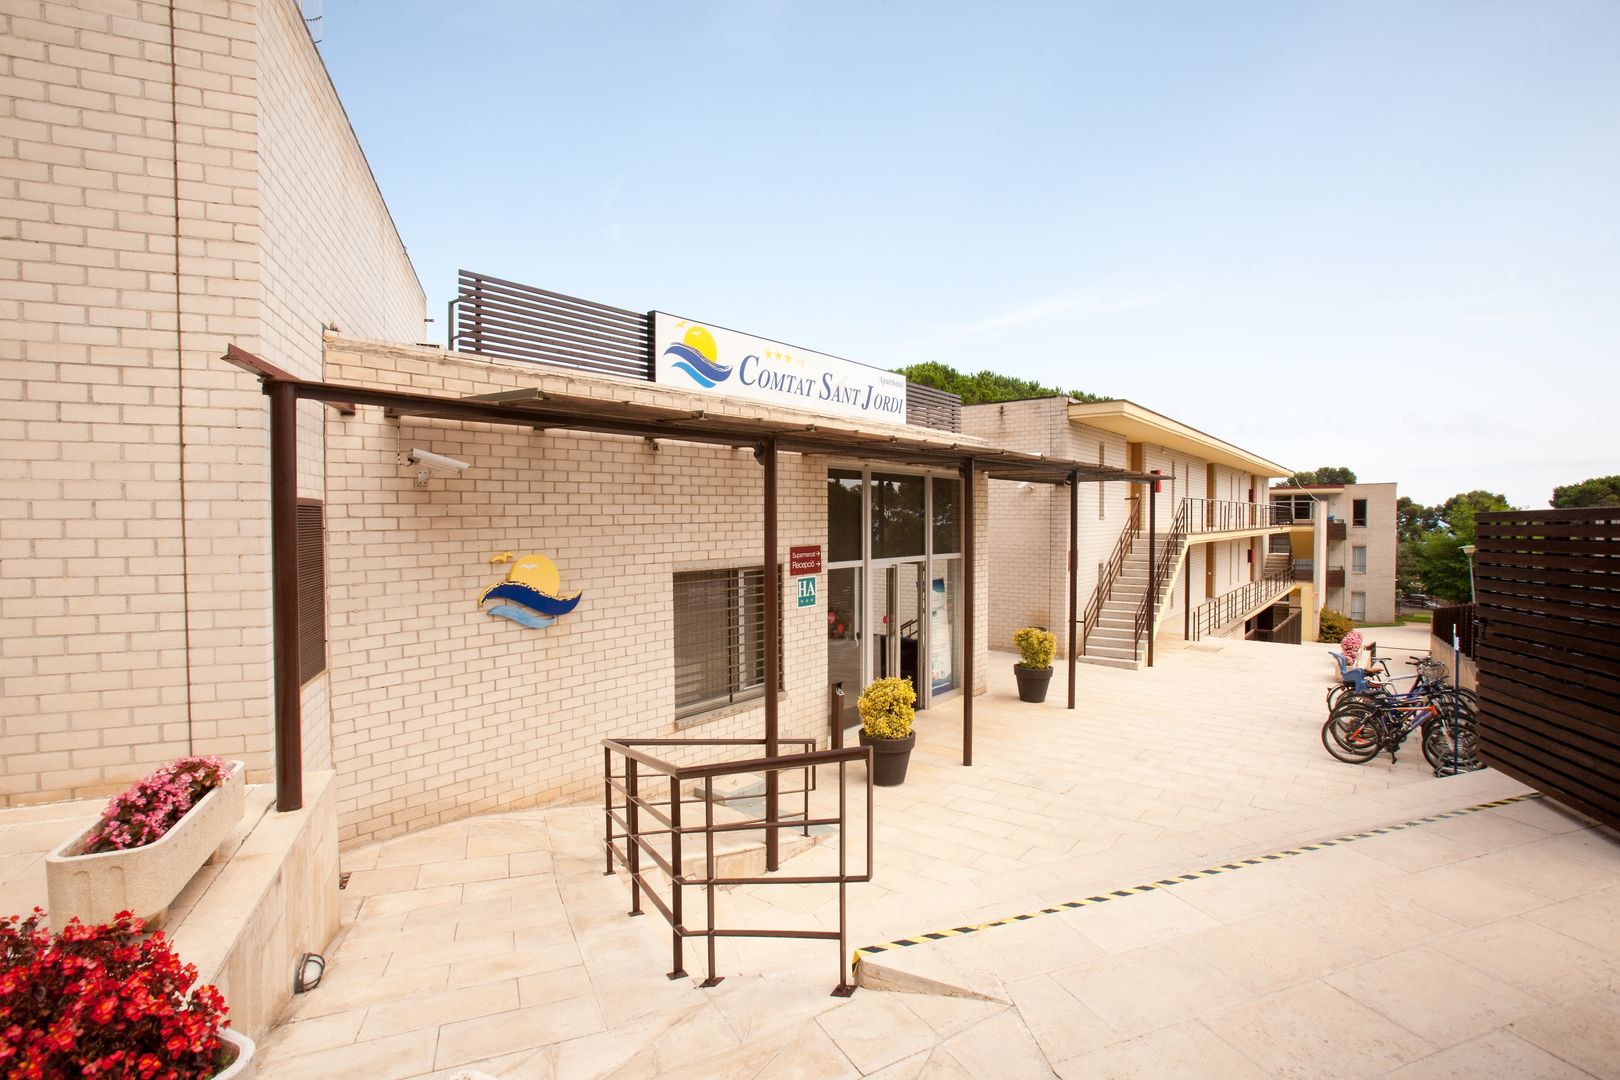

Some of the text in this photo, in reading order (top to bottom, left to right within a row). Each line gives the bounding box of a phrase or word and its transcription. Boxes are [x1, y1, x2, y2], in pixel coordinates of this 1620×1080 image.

[739, 354, 903, 414] COMTAT SANT JORDI
[792, 560, 815, 570] Recepció
[798, 581, 815, 598] HA
